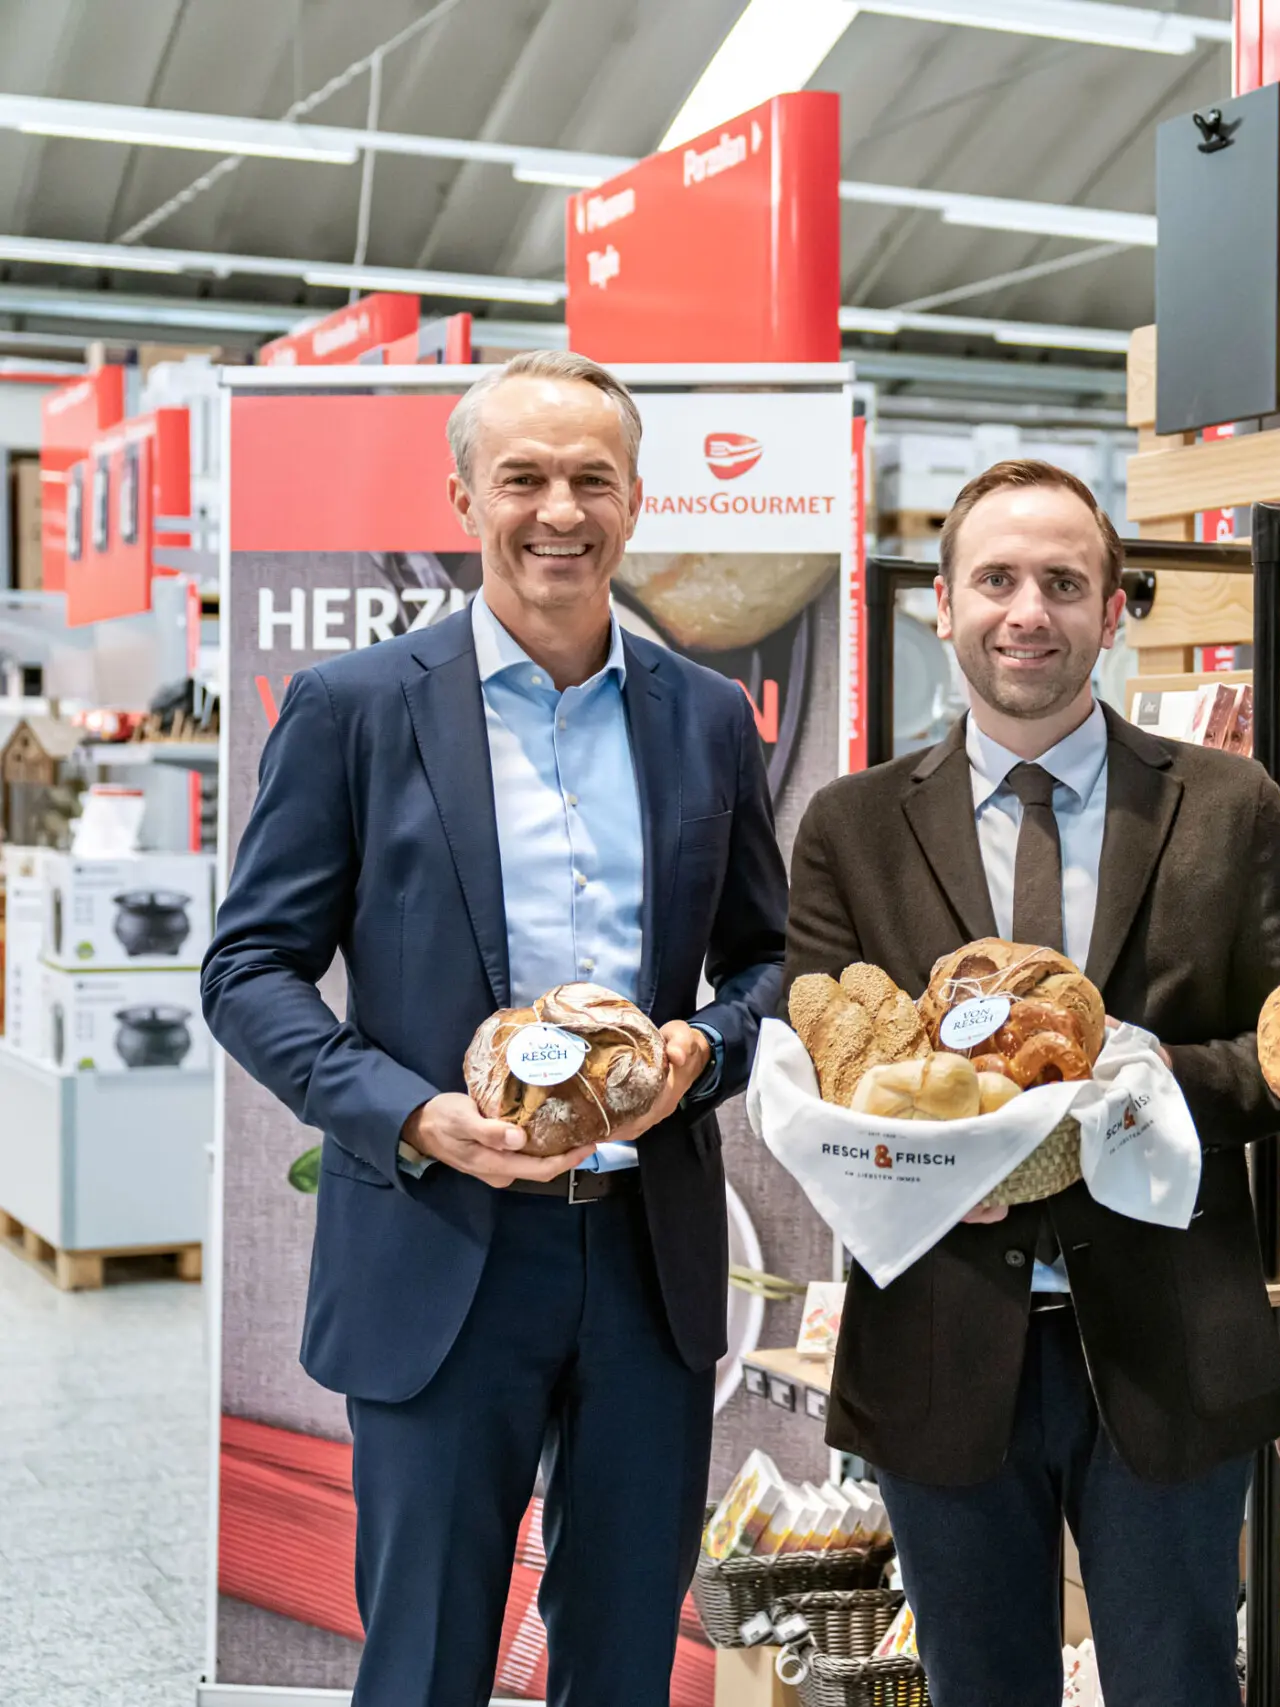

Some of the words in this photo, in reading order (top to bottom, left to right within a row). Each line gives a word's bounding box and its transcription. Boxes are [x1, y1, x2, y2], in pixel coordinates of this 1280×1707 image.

[645, 491, 836, 514] RANSGOURMET
[258, 587, 467, 650] HERZ
[953, 1014, 994, 1031] RESCH
[963, 1007, 991, 1020] VON
[521, 1049, 568, 1062] RESCH
[822, 1143, 870, 1160] RESCH
[895, 1151, 956, 1166] FRISCH
